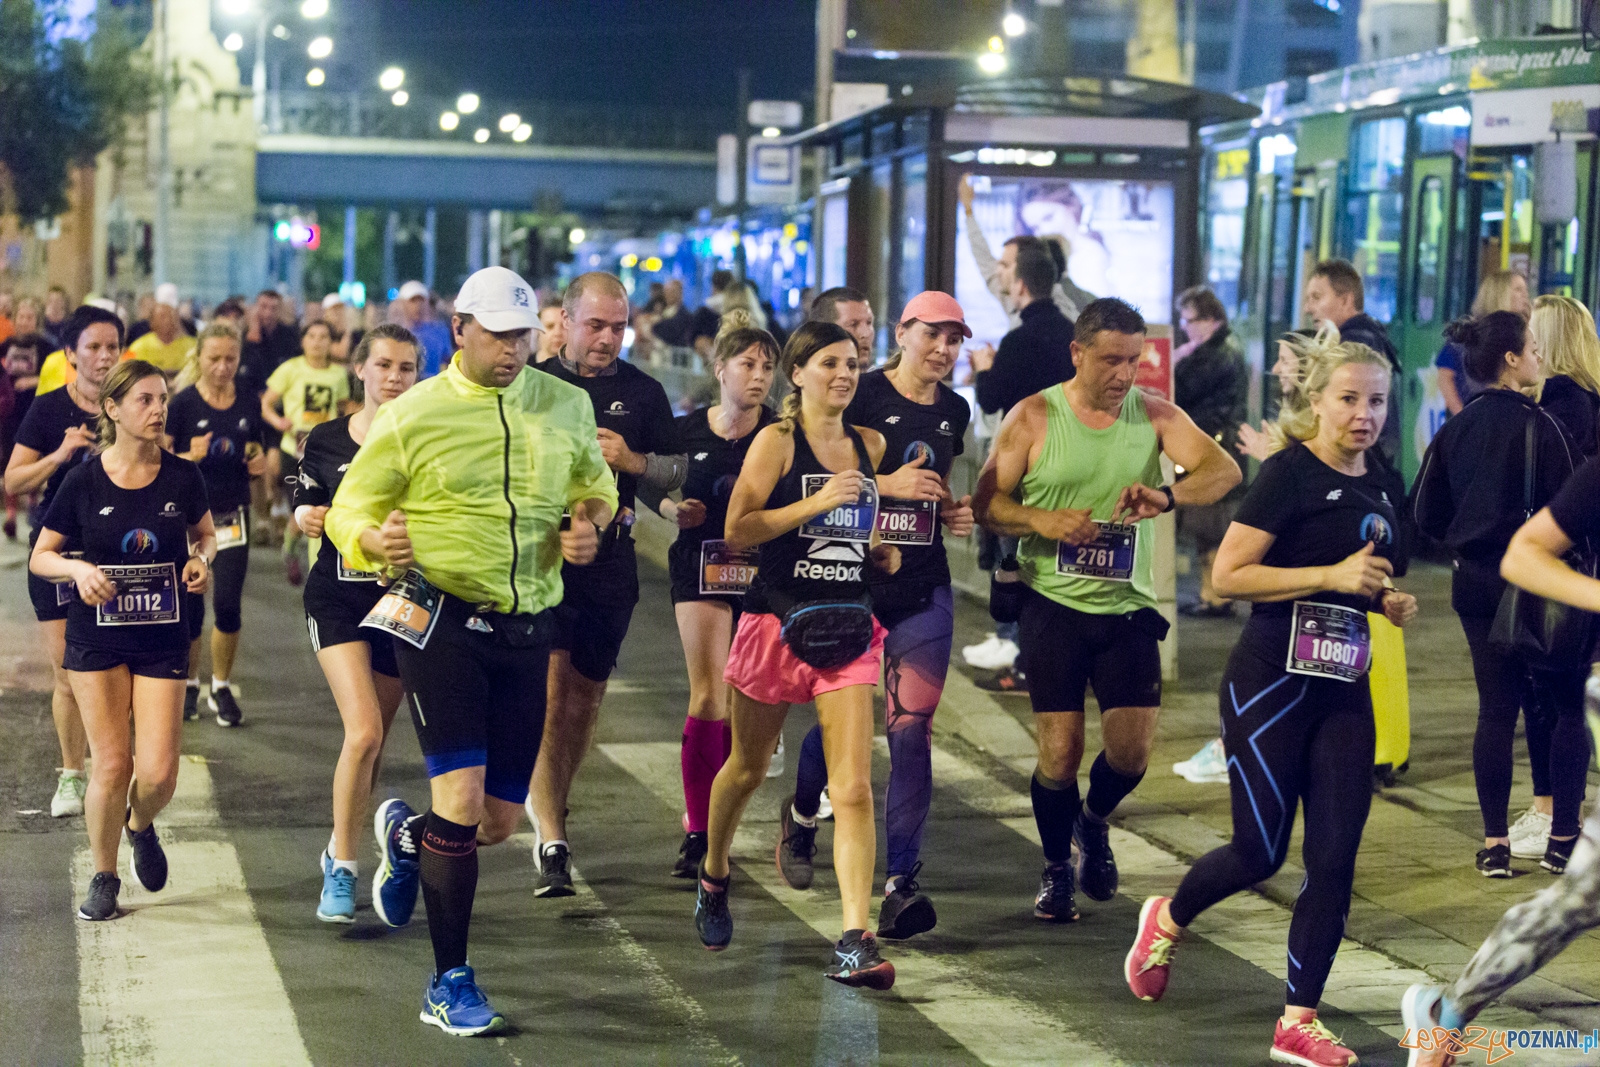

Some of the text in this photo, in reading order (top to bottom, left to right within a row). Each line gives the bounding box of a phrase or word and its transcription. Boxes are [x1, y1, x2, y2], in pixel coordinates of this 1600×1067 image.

[884, 416, 901, 424] 4F
[1326, 489, 1342, 500] 4F
[99, 506, 115, 516] 4F
[824, 507, 859, 527] 3061
[880, 512, 917, 531] 7082
[1076, 547, 1115, 567] 2761
[719, 566, 755, 583] 3937
[793, 560, 863, 581] Reebok
[116, 593, 162, 612] 10112
[1312, 638, 1359, 666] 10807
